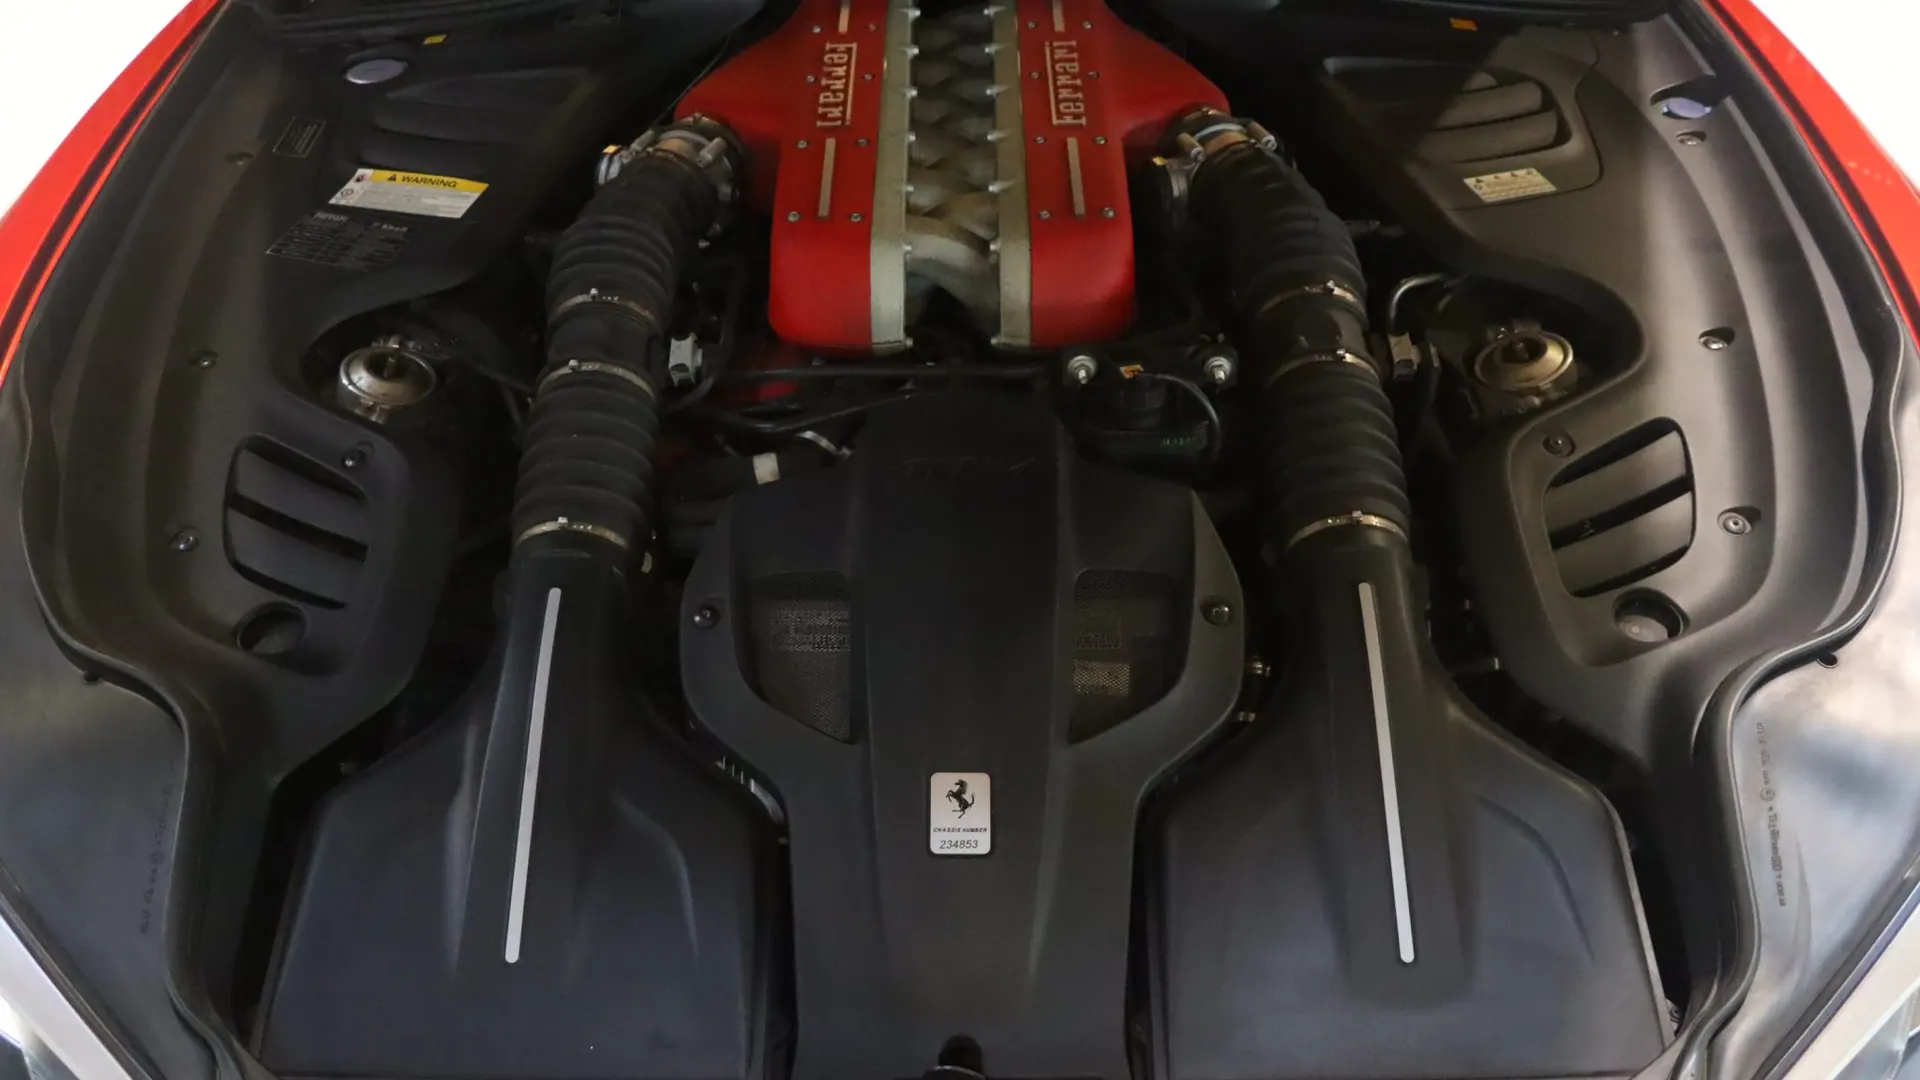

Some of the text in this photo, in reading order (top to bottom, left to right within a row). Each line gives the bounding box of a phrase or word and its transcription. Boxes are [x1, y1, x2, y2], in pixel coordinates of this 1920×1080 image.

[816, 42, 857, 127] Ferrari
[1045, 40, 1087, 126] Ferrari
[401, 175, 458, 188] WARNING
[940, 839, 979, 850] 234853
